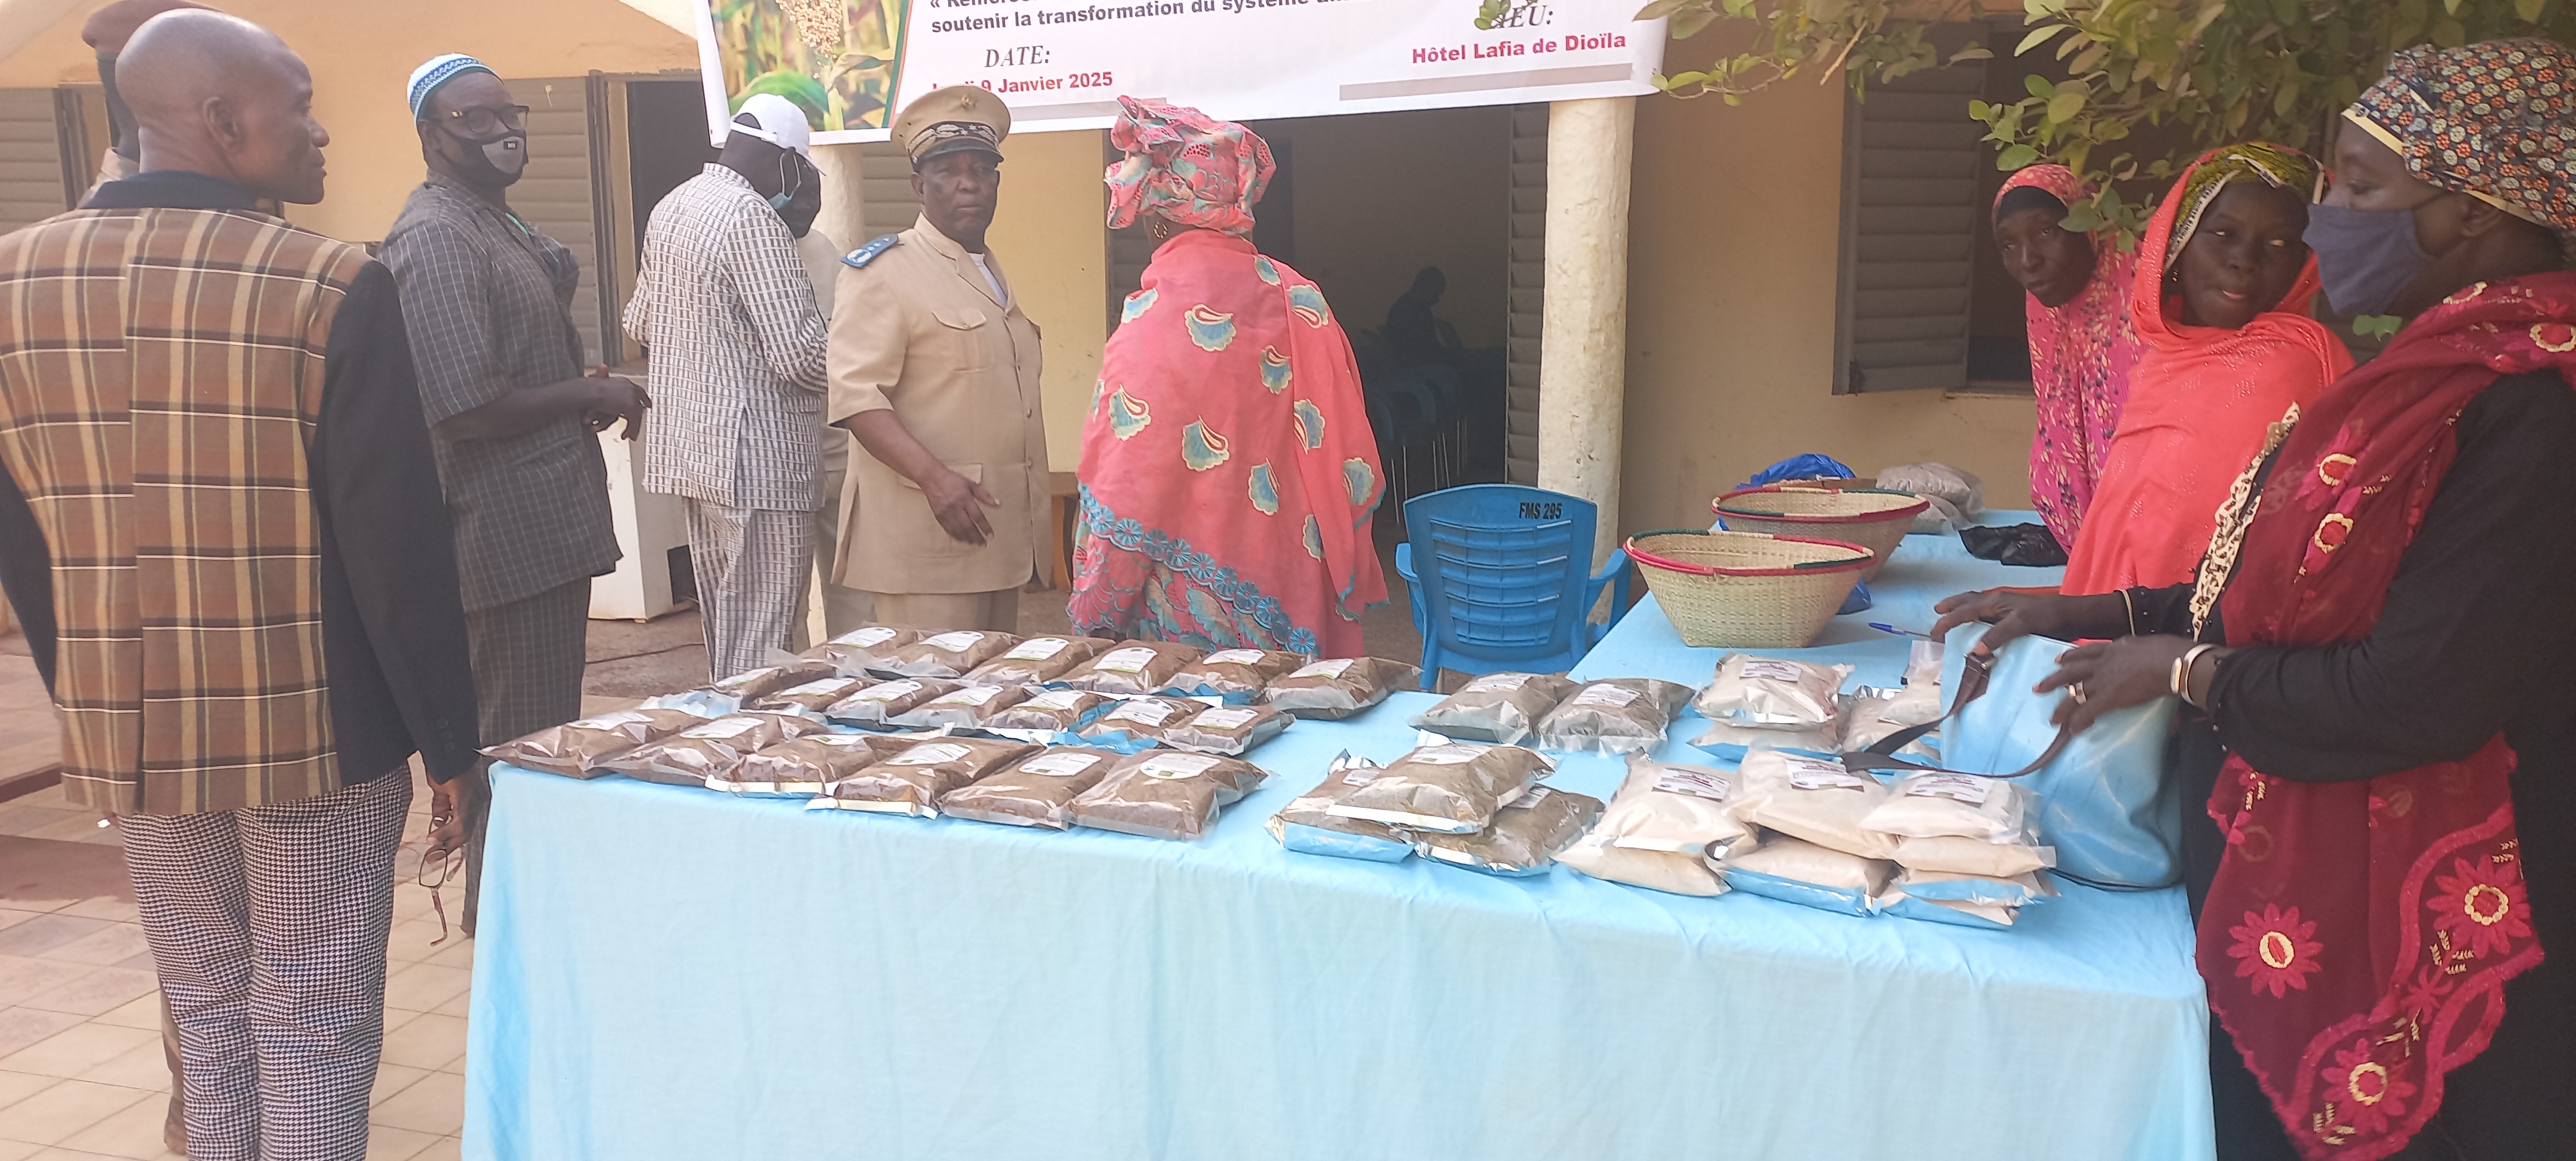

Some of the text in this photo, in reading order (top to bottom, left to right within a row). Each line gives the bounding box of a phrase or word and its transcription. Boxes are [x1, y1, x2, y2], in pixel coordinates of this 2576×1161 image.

[931, 13, 1009, 33] soutenir
[1014, 11, 1032, 27] la
[1037, 0, 1184, 25] transformation
[1191, 0, 1216, 13] du
[1222, 0, 1309, 14] syst
[1487, 5, 1553, 28] IEU:
[984, 45, 1050, 68] DATE:
[1412, 32, 1626, 64] Hôtel Lafia de Dioïla
[981, 80, 992, 91] 9
[997, 76, 1063, 93] Janvier
[1069, 71, 1113, 89] 2025
[1519, 503, 1541, 520] FMS
